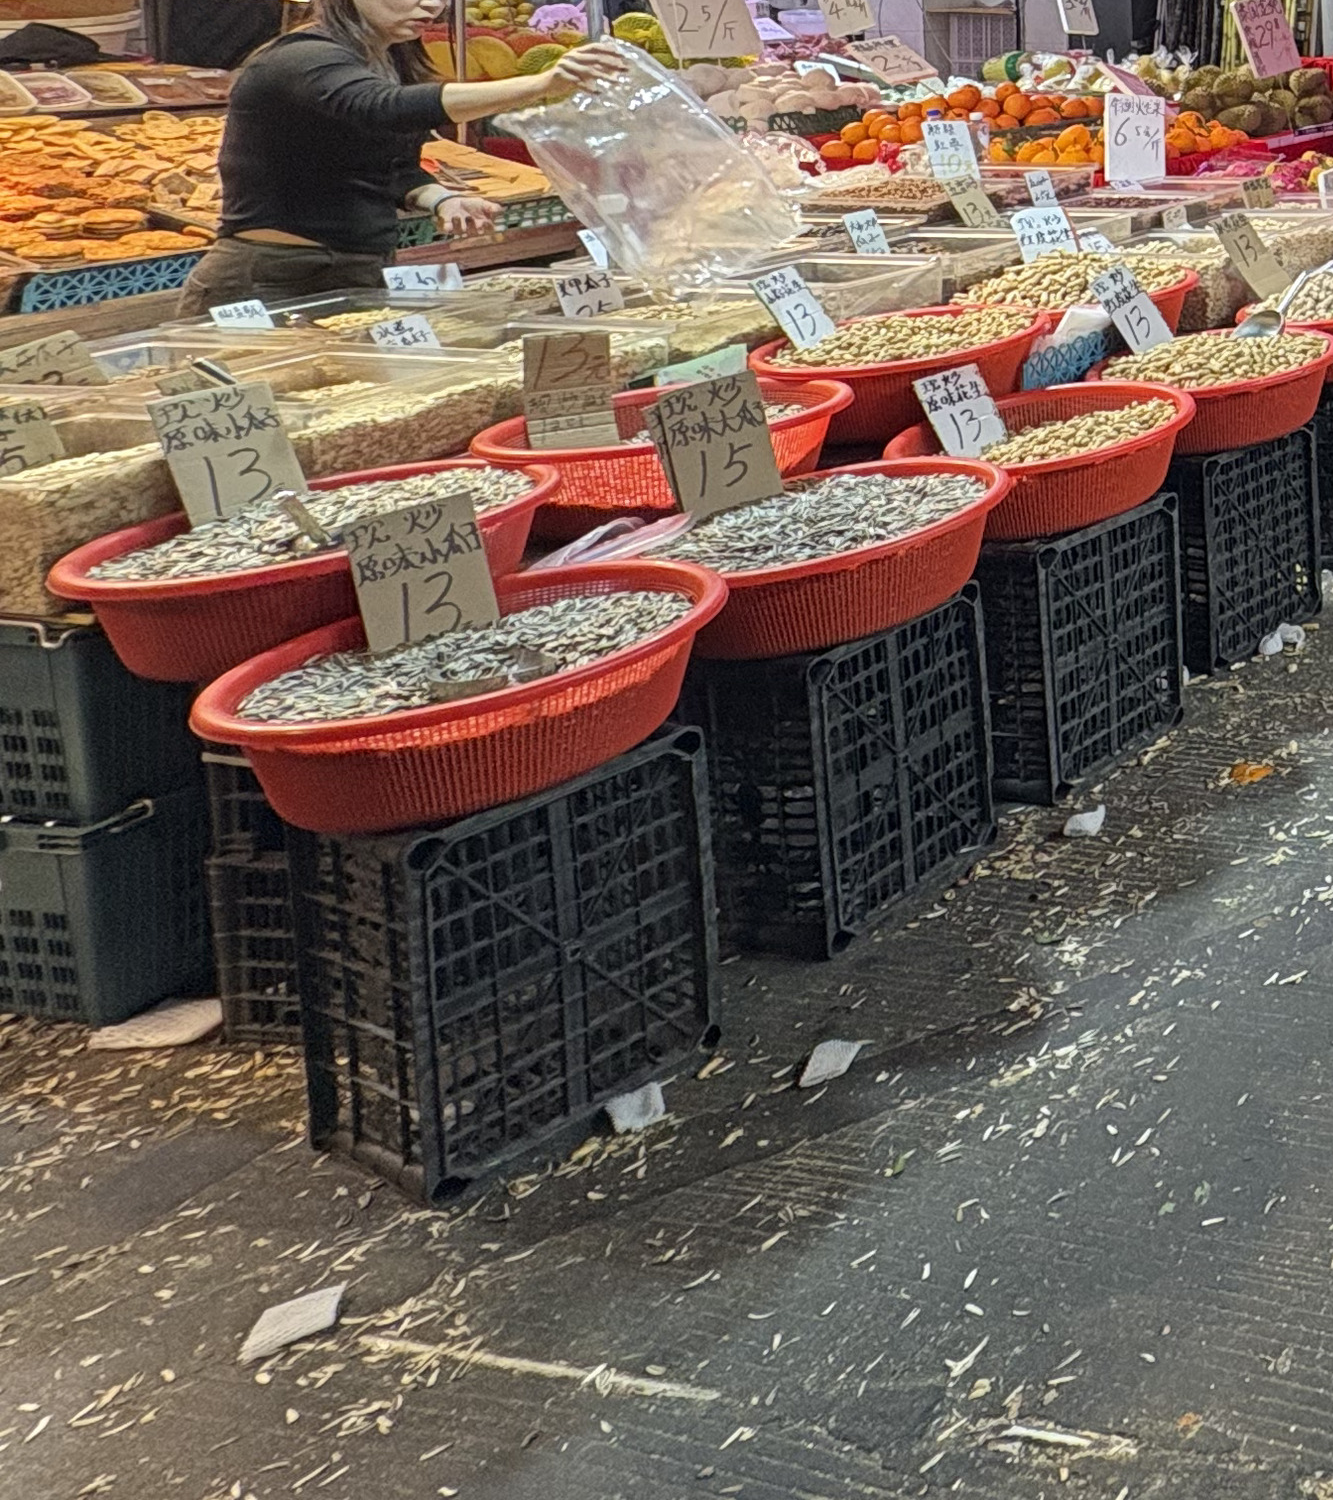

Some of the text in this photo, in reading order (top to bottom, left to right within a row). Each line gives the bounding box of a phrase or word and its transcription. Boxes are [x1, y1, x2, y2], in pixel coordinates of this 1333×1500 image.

[1233, 234, 1258, 268] 13
[786, 303, 817, 341] 13
[1124, 305, 1151, 345] 13
[949, 408, 982, 449] 13
[203, 447, 272, 518] 13
[699, 442, 753, 497] 15
[401, 571, 463, 642] 13
